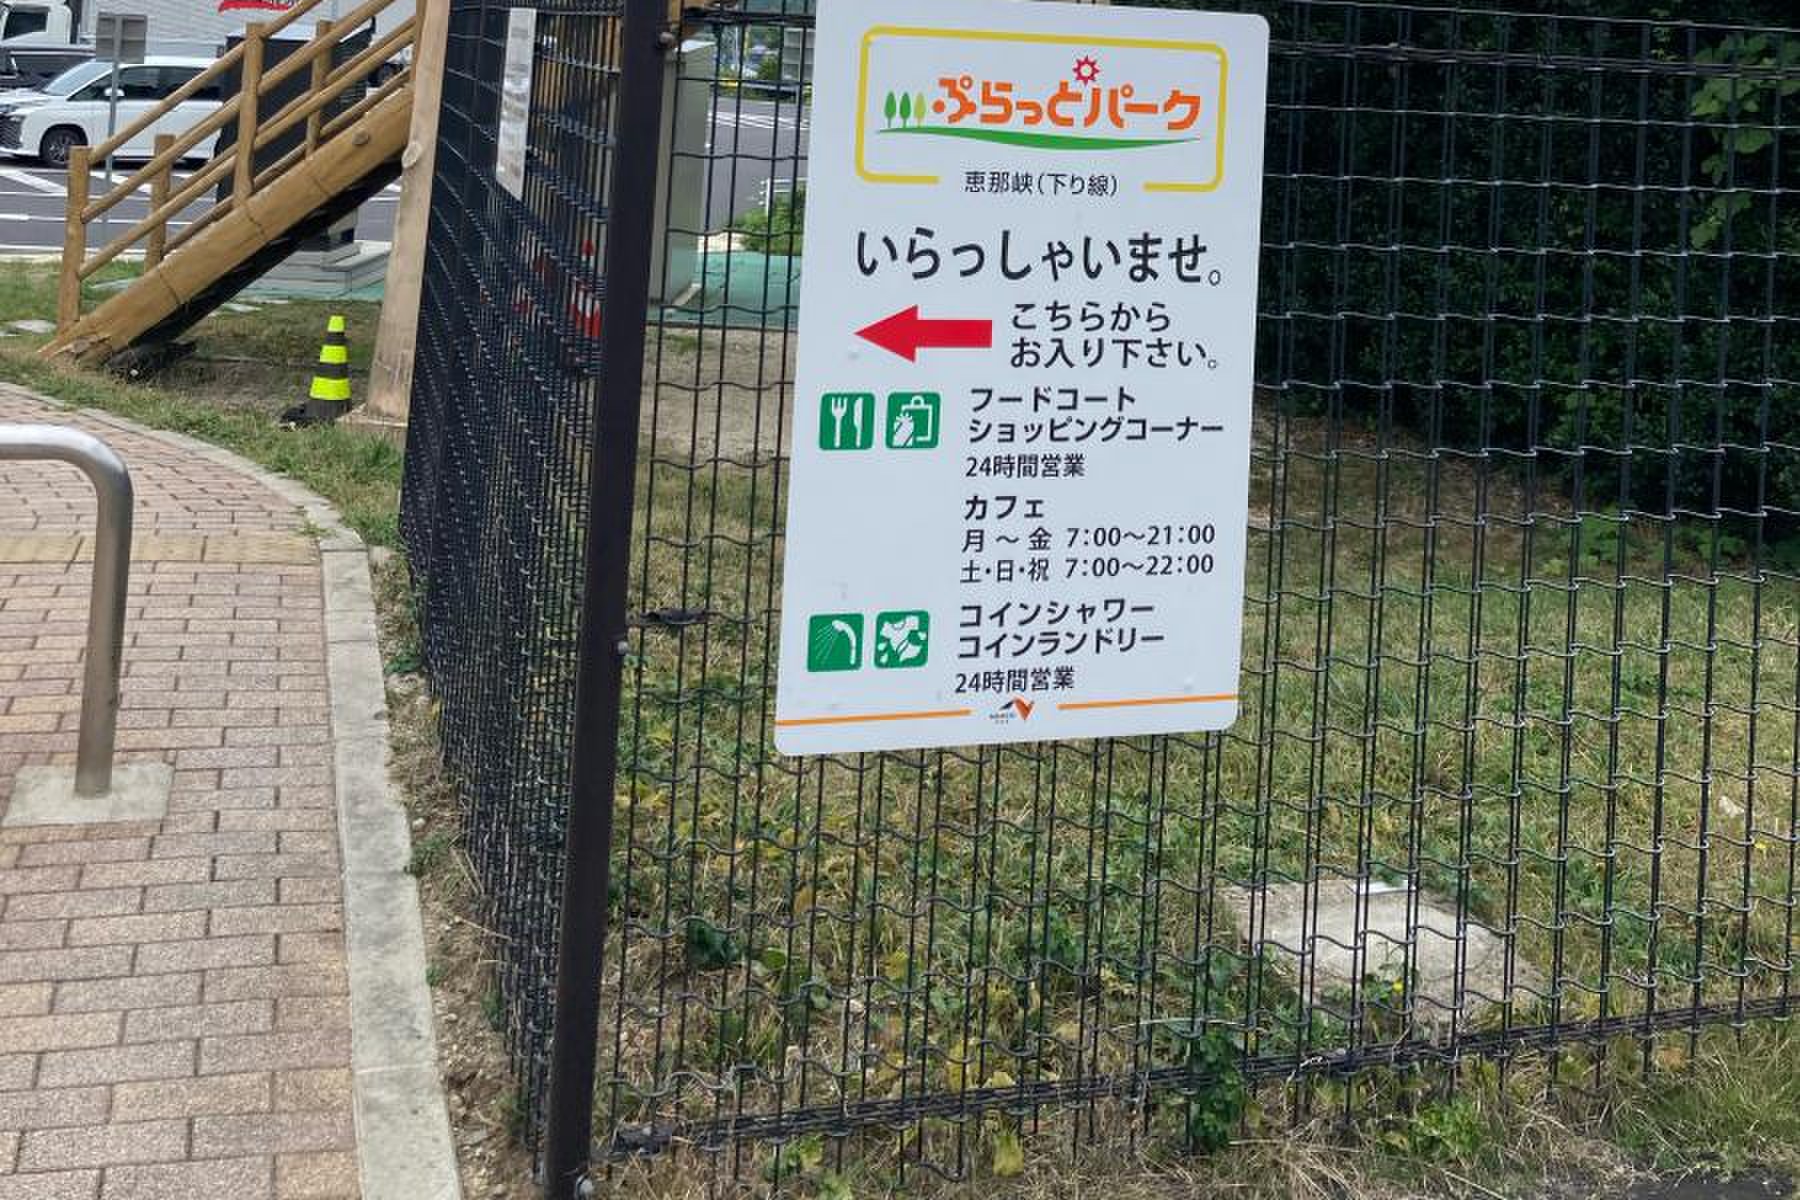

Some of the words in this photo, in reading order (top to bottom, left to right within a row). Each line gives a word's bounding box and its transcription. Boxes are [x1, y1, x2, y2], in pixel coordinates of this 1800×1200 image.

[856, 226, 1223, 287] いらっしゃいませ。
[1010, 300, 1172, 333] こちらから
[1009, 335, 1219, 370] お入り下さい。
[969, 385, 1137, 414] フードコート
[968, 414, 1225, 445] ショッピングコーナー
[964, 452, 1086, 479] 24時間営業
[963, 494, 1046, 521] カフェ
[958, 597, 1156, 629] コインシャワー
[956, 626, 1167, 660] コインランドリー
[953, 665, 1077, 695] 24時間営業
